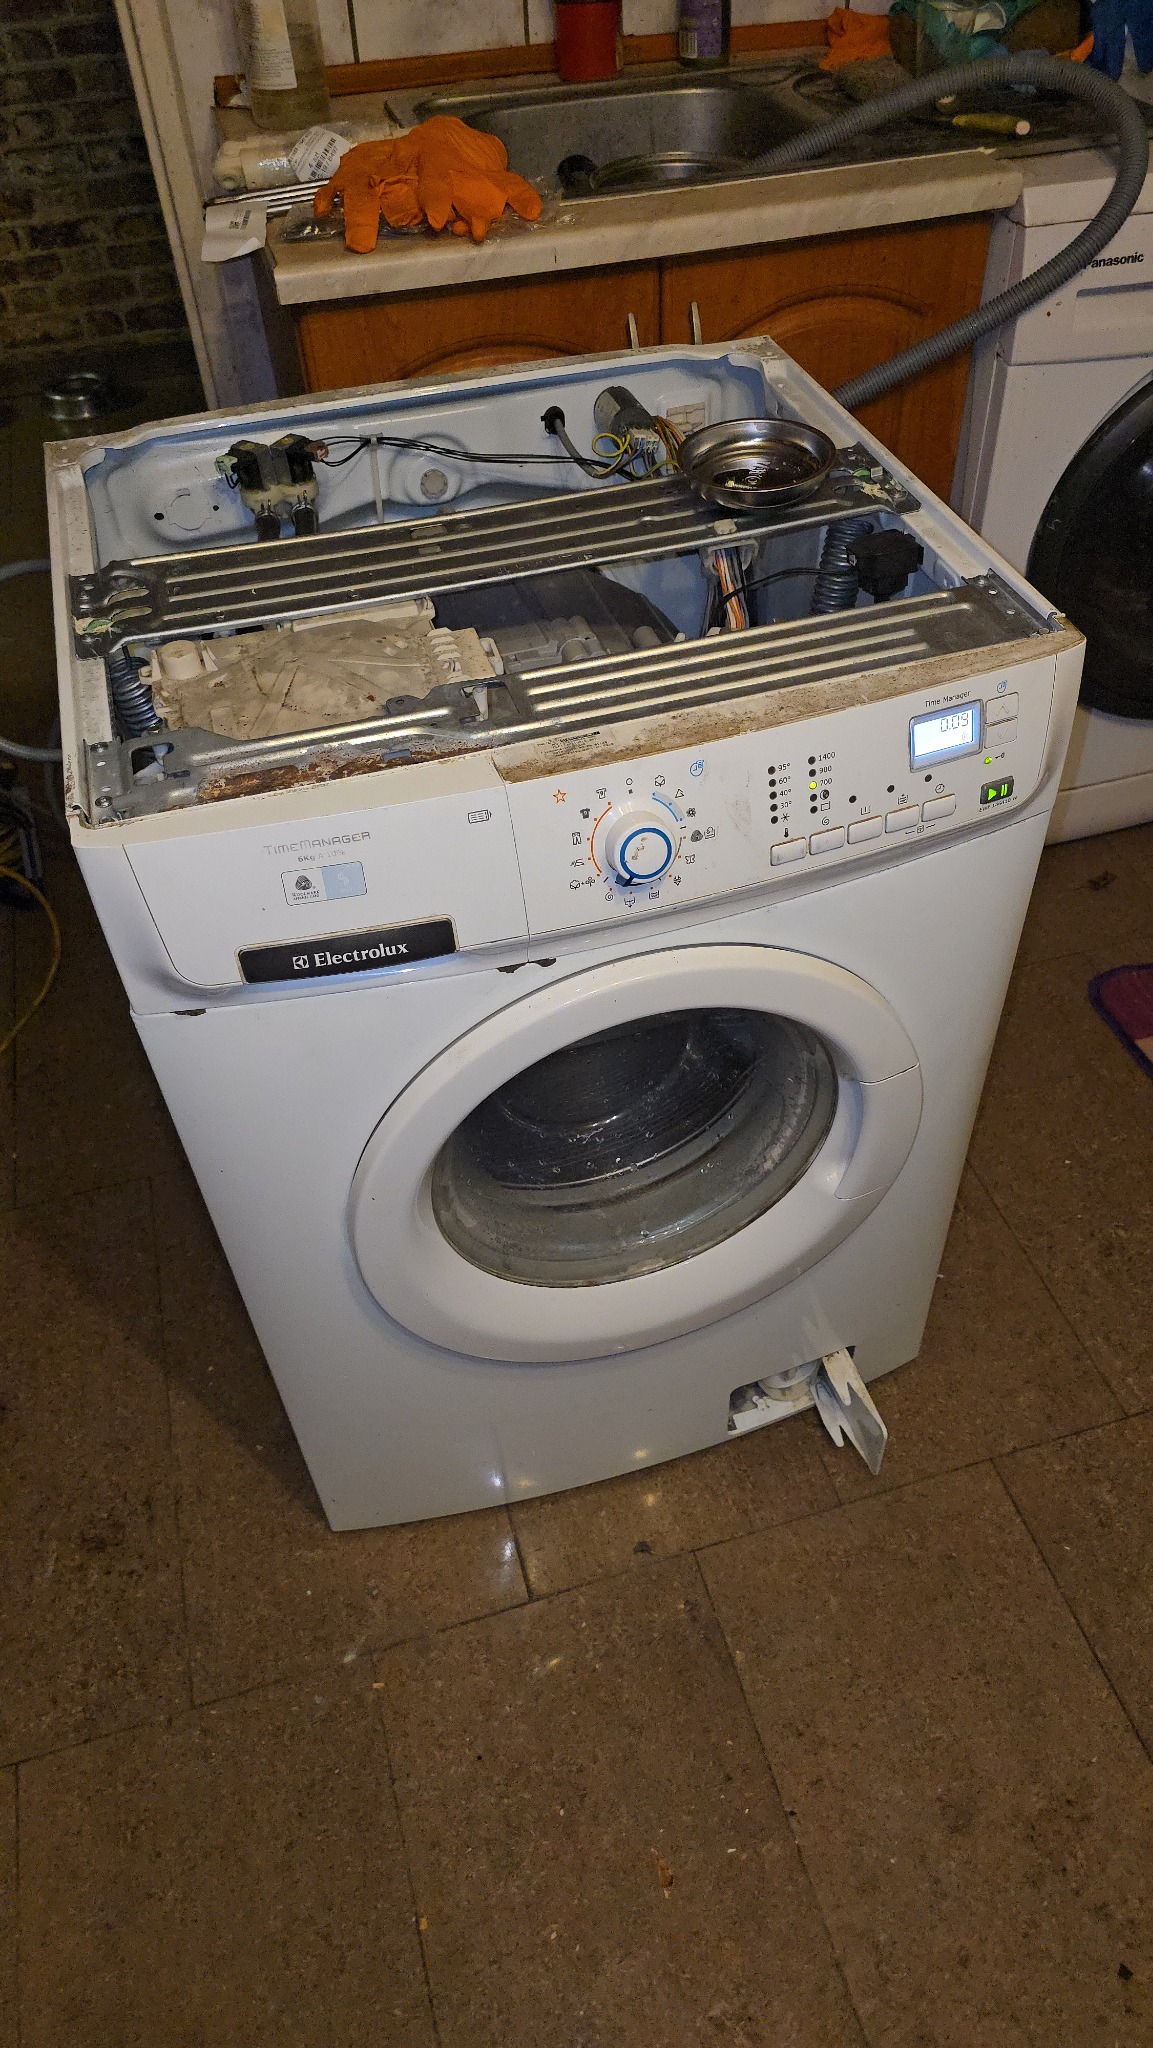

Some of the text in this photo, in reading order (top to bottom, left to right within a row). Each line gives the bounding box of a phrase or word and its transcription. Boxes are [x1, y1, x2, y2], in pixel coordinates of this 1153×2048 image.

[925, 690, 971, 708] Time Manager
[818, 751, 836, 762] 1400
[313, 943, 409, 968] Electrolux
